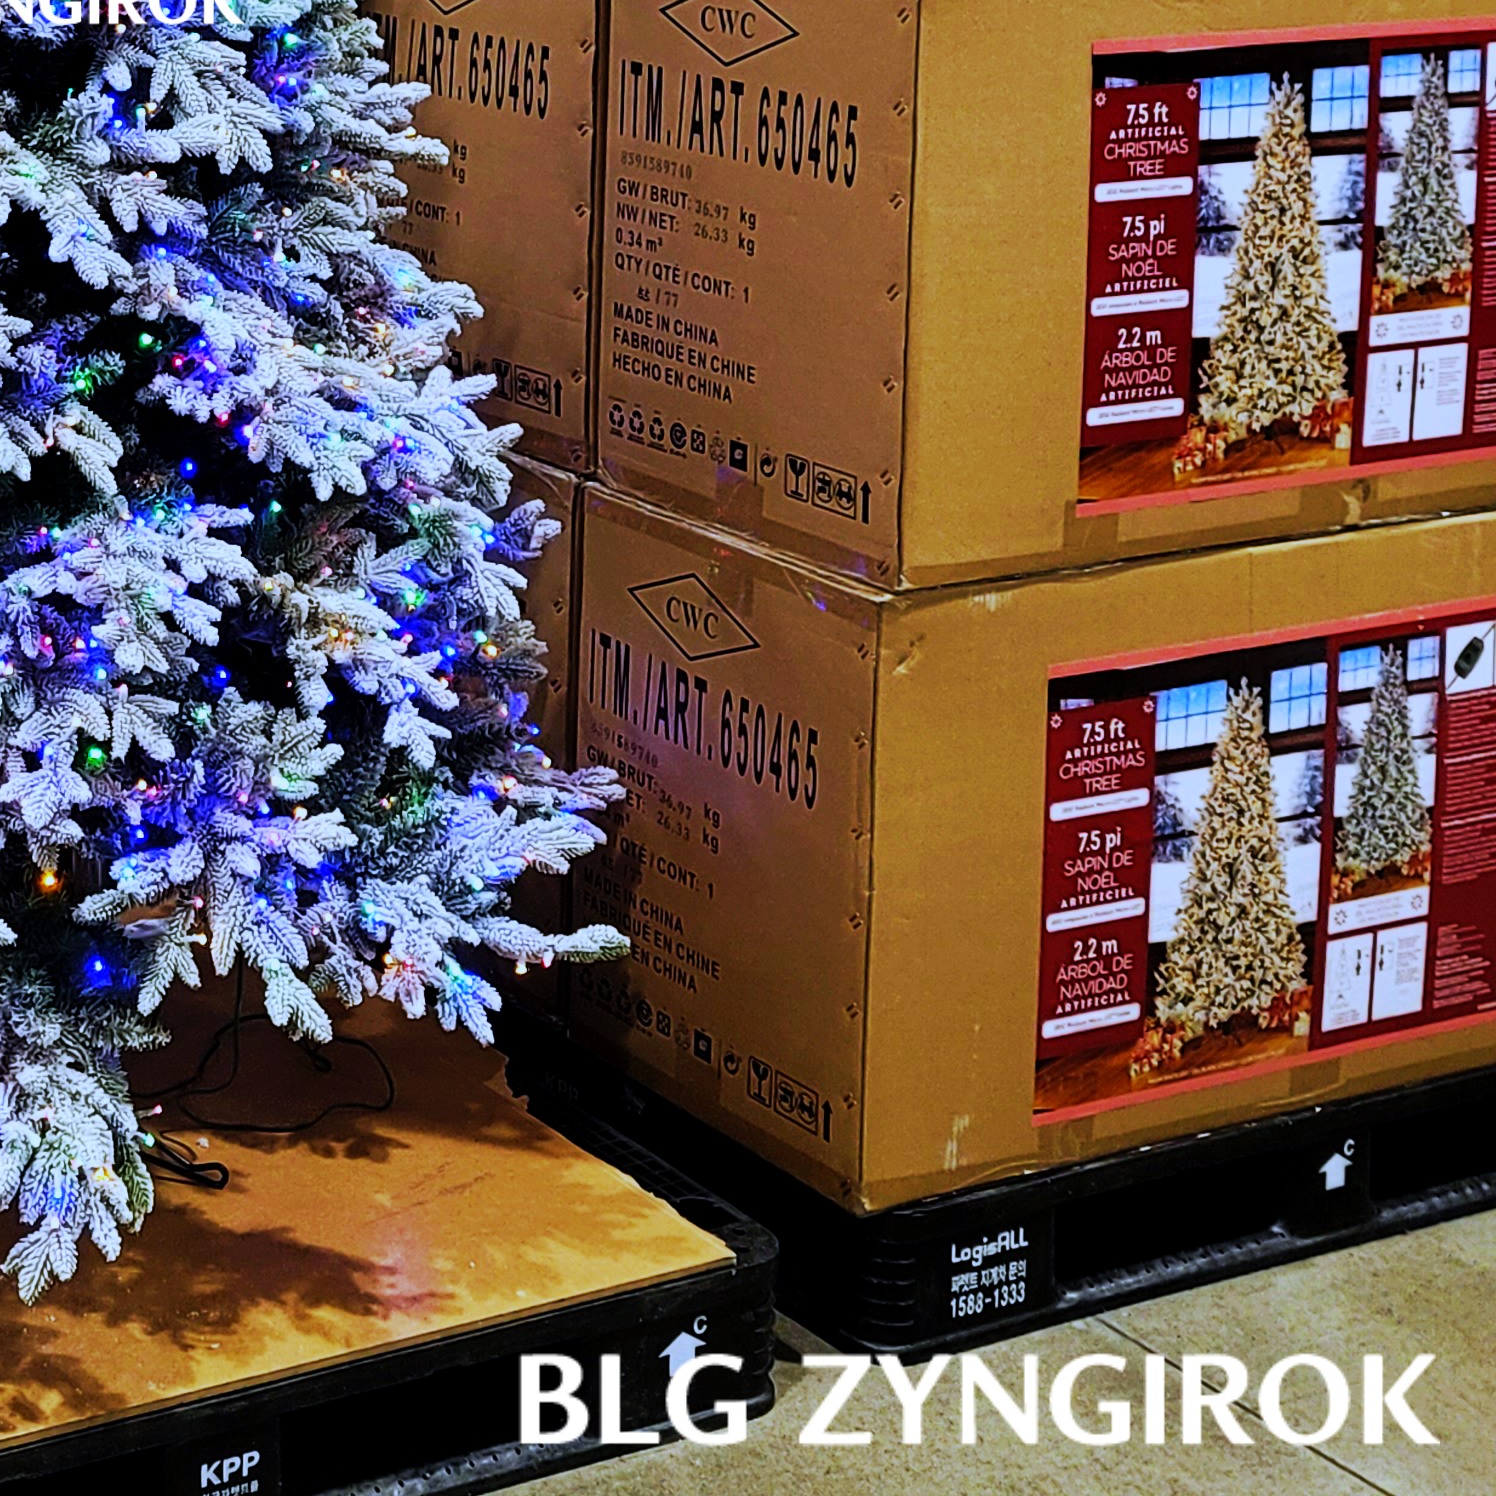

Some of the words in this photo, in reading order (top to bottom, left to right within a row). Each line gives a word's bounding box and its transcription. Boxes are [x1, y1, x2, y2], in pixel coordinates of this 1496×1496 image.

[700, 6, 757, 40] CWC
[468, 31, 550, 120] 650465
[1126, 104, 1149, 126] 7.5
[1153, 101, 1169, 124] ft
[758, 86, 859, 188] 650465
[1109, 126, 1185, 140] ARTIFICIAL
[1104, 138, 1189, 160] CHRISTMAS
[1127, 159, 1165, 177] TREE
[739, 206, 757, 231] kg
[1122, 216, 1145, 238] 7.5
[1150, 214, 1165, 241] pi
[615, 227, 643, 249] 0.34
[738, 232, 756, 257] kg
[1108, 241, 1153, 261] SAPIN
[1156, 238, 1177, 255] DE
[1121, 258, 1163, 279] NOËL
[1105, 277, 1179, 293] ARTIFICIEL
[613, 302, 653, 328] MADE
[656, 313, 670, 333] IN
[673, 319, 719, 346] CHINA
[1118, 327, 1142, 349] 2.2
[1146, 329, 1162, 346] m
[688, 349, 707, 369] EN
[710, 355, 756, 384] CHINE
[1100, 349, 1153, 371] ÁRBOL
[1156, 347, 1177, 364] DE
[612, 351, 661, 382] HECHO
[664, 367, 683, 389] EN
[686, 374, 733, 404] CHINA
[1104, 366, 1172, 388] NAVIDAD
[1100, 385, 1175, 403] ARTIFICIAL
[665, 596, 719, 640] CWC
[1082, 721, 1105, 744] 7.5
[1108, 717, 1126, 739] ft
[720, 689, 819, 810] 650465
[1065, 739, 1142, 760] ARTIFICIAL
[1059, 751, 1146, 780] CHRISTMAS
[1083, 774, 1122, 794] TREE
[1078, 830, 1102, 853] 7.5
[1106, 826, 1122, 854] pi
[1063, 855, 1108, 877] SAPIN
[1112, 850, 1134, 868] DE
[1059, 974, 1127, 1001] NAVIDAD
[951, 1227, 1029, 1267] LogisALL
[950, 1281, 1026, 1319] 1588-1333
[693, 1315, 708, 1335] C
[200, 1450, 260, 1488] KPP
